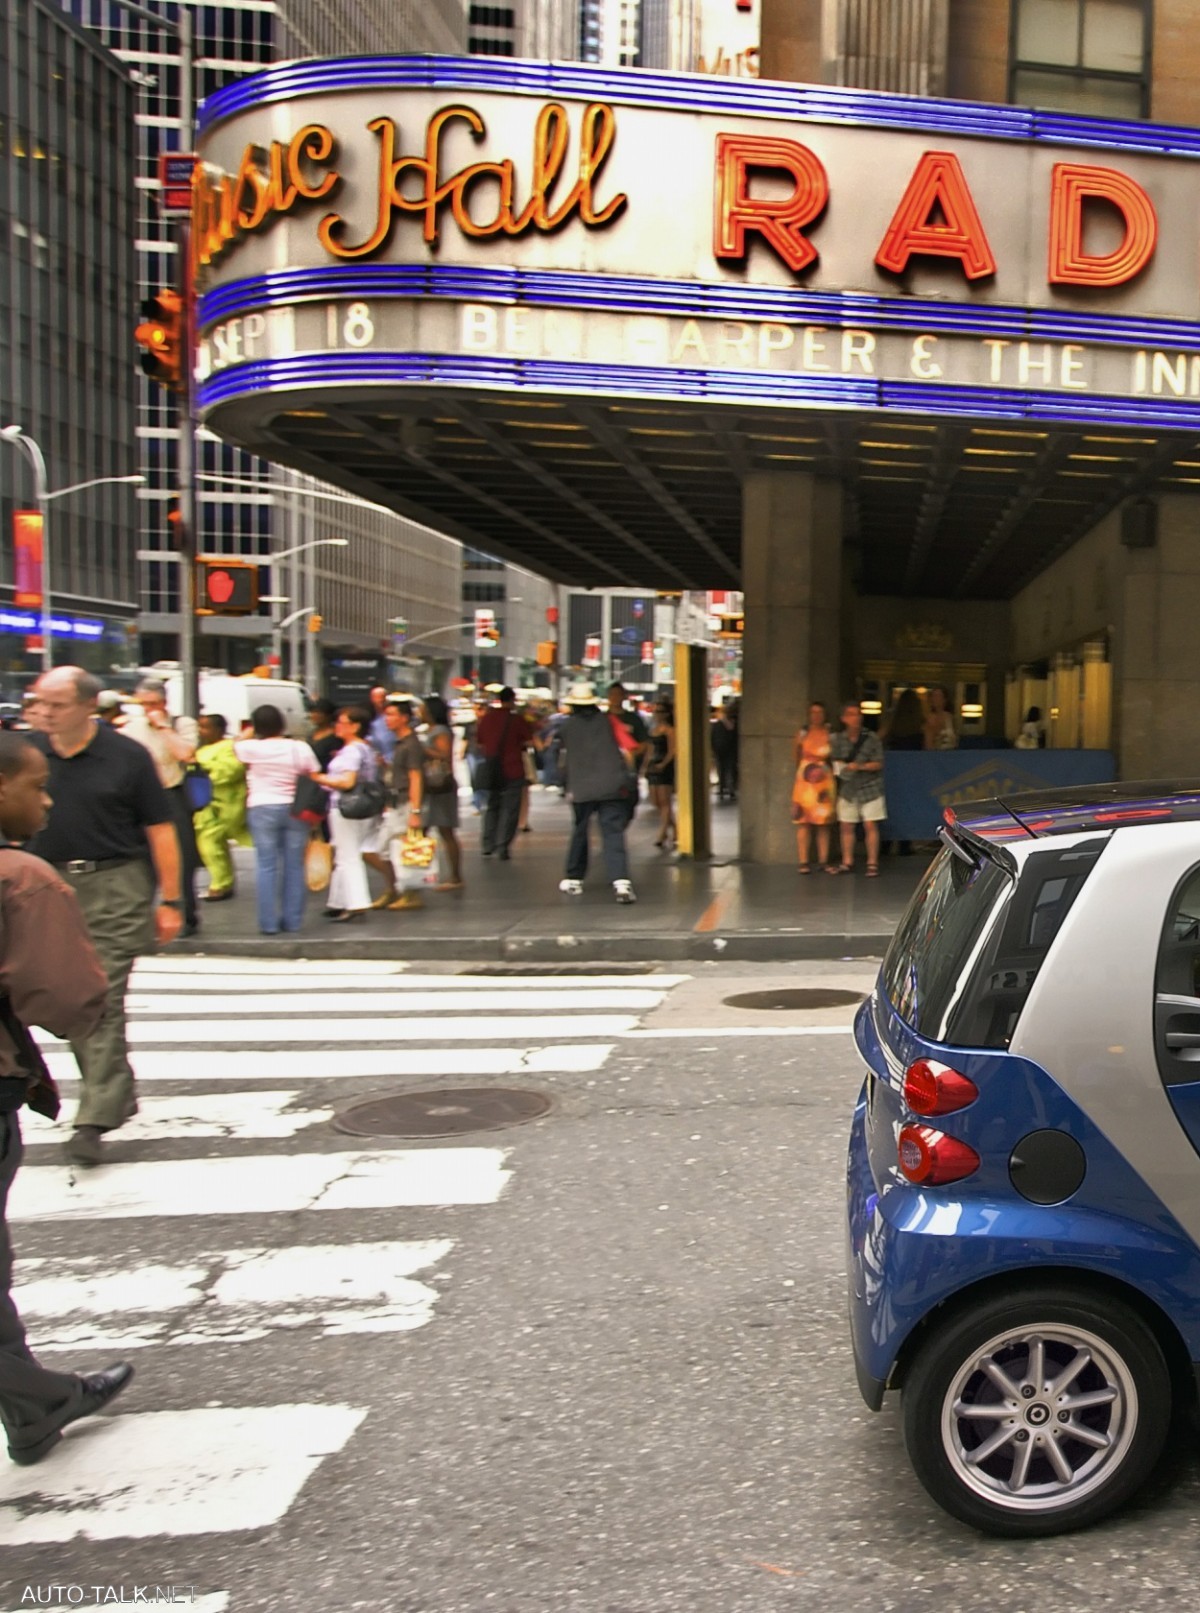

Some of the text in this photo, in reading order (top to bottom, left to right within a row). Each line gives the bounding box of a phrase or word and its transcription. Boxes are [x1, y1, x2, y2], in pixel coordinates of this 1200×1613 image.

[193, 104, 627, 265] sic Hall
[327, 302, 375, 348] 18
[910, 335, 942, 380] &
[981, 339, 1088, 389] THE
